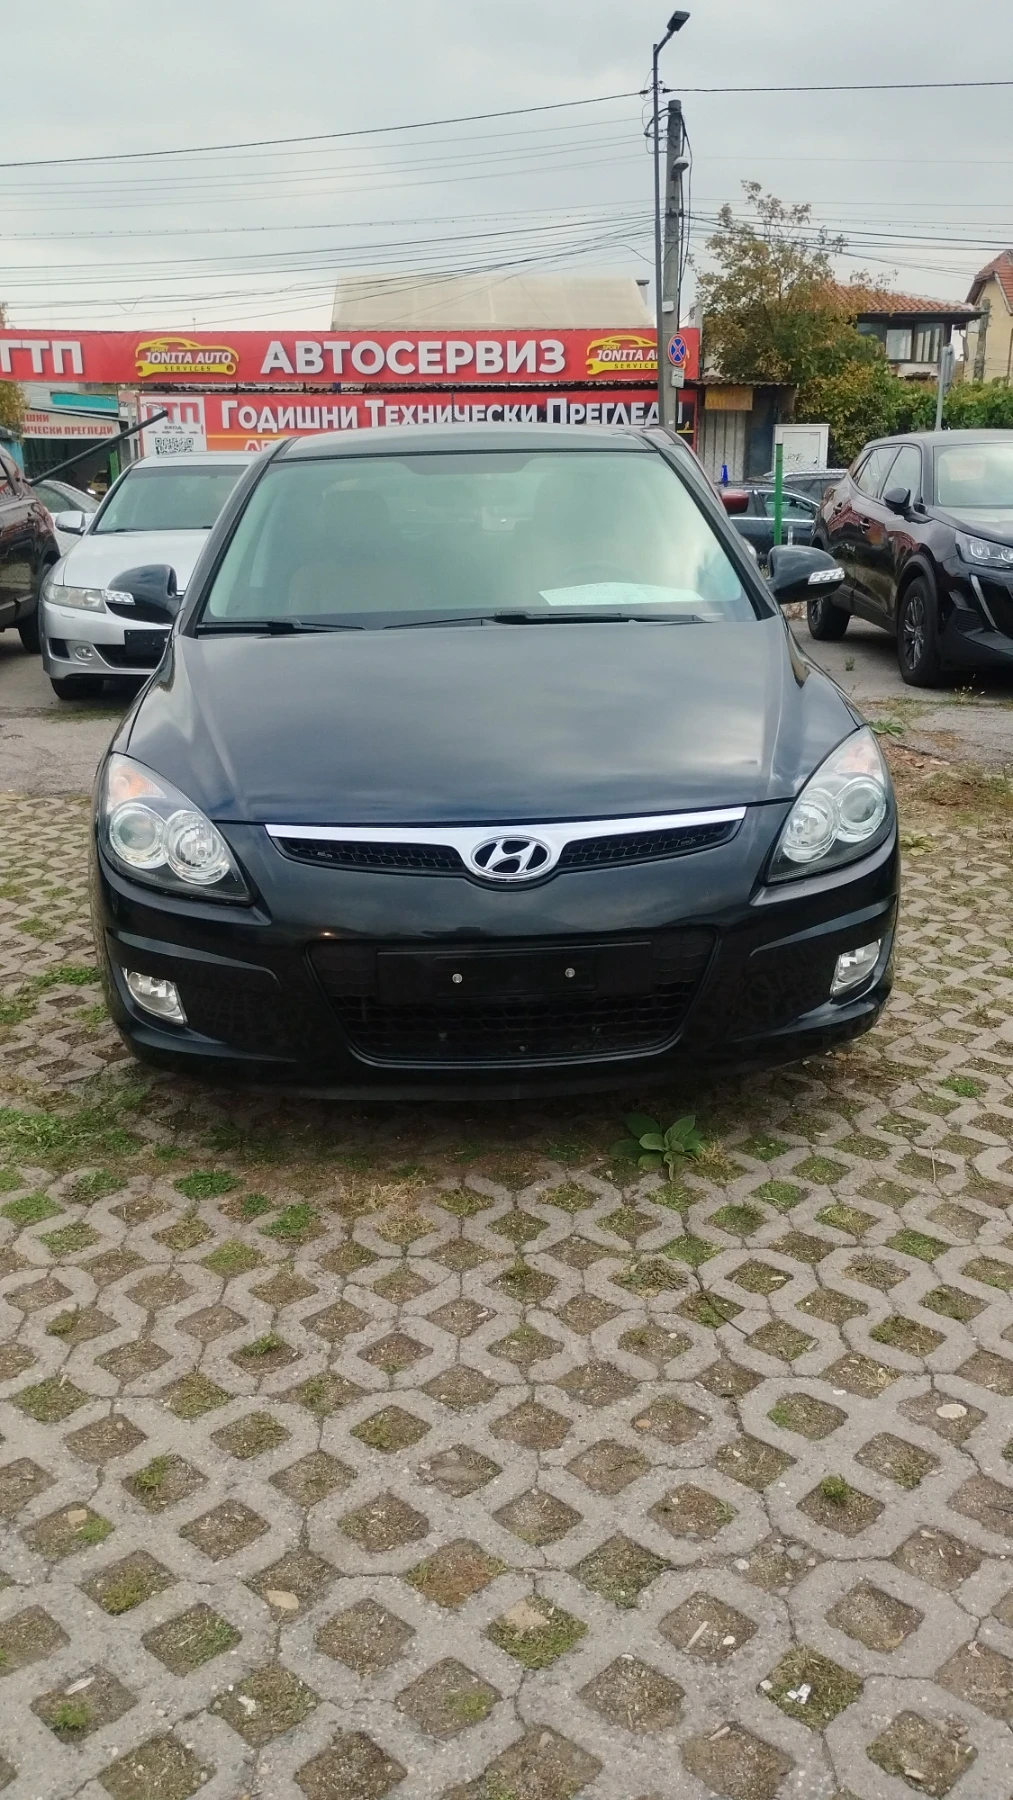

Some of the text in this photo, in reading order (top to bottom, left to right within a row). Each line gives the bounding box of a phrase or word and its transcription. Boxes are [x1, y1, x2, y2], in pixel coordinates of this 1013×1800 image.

[0, 340, 83, 374] ГТП
[145, 351, 232, 364] JONITA AUTO
[260, 339, 566, 374] АВТОСЕРВИЗ
[596, 349, 643, 361] JONITA
[25, 414, 49, 422] ШНИ
[23, 425, 113, 435] ИЧЕСКИ ПРЕГЛЕДИ
